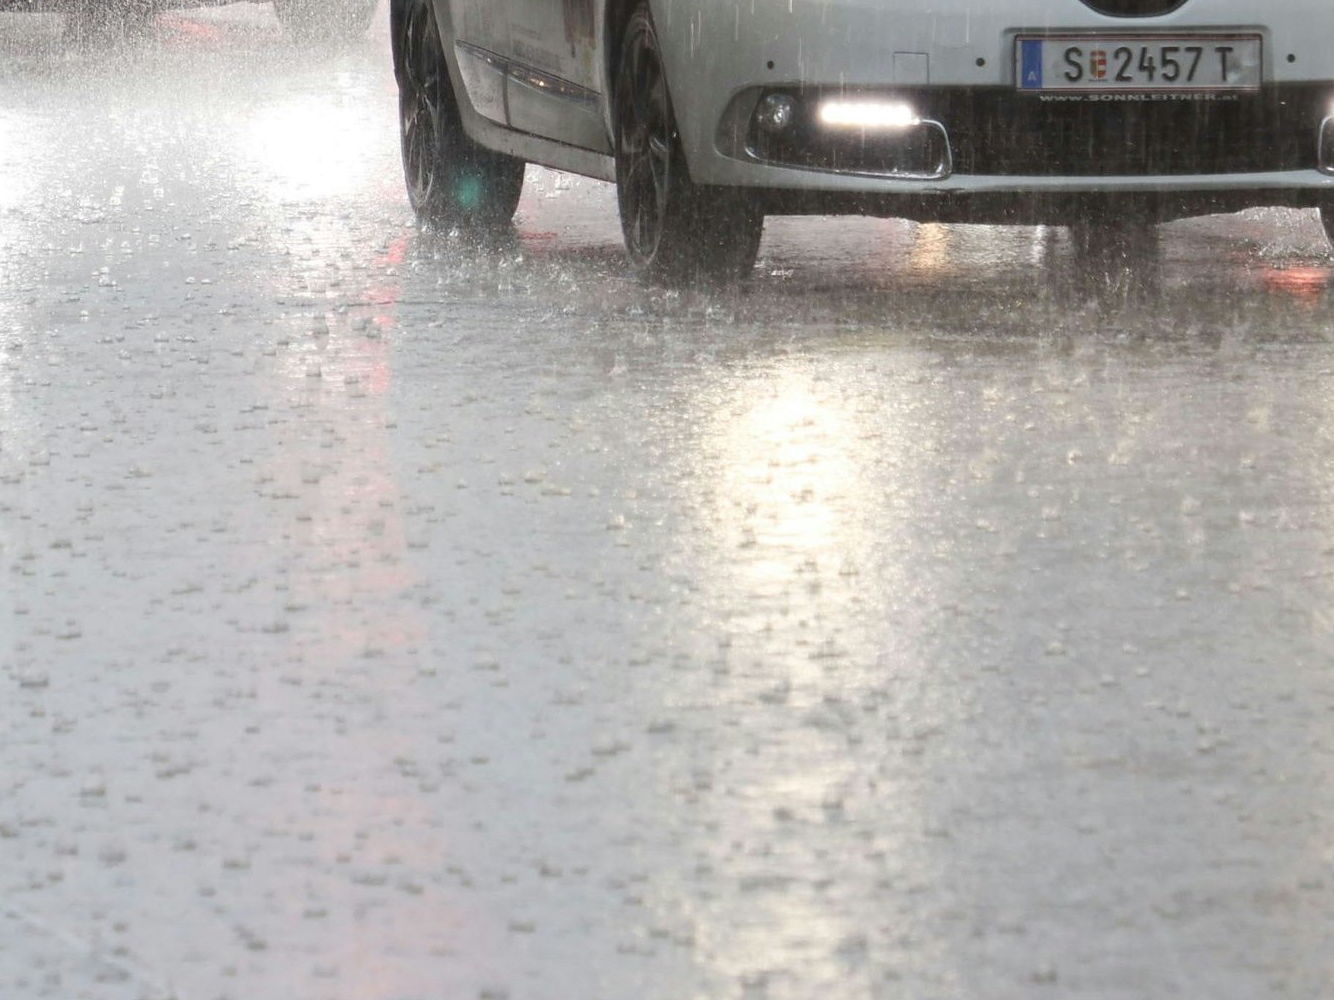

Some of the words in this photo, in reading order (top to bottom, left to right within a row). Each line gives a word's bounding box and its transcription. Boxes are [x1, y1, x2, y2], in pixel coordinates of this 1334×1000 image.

[1064, 47, 1084, 82] S
[1114, 46, 1203, 82] 2457
[1215, 47, 1234, 81] T
